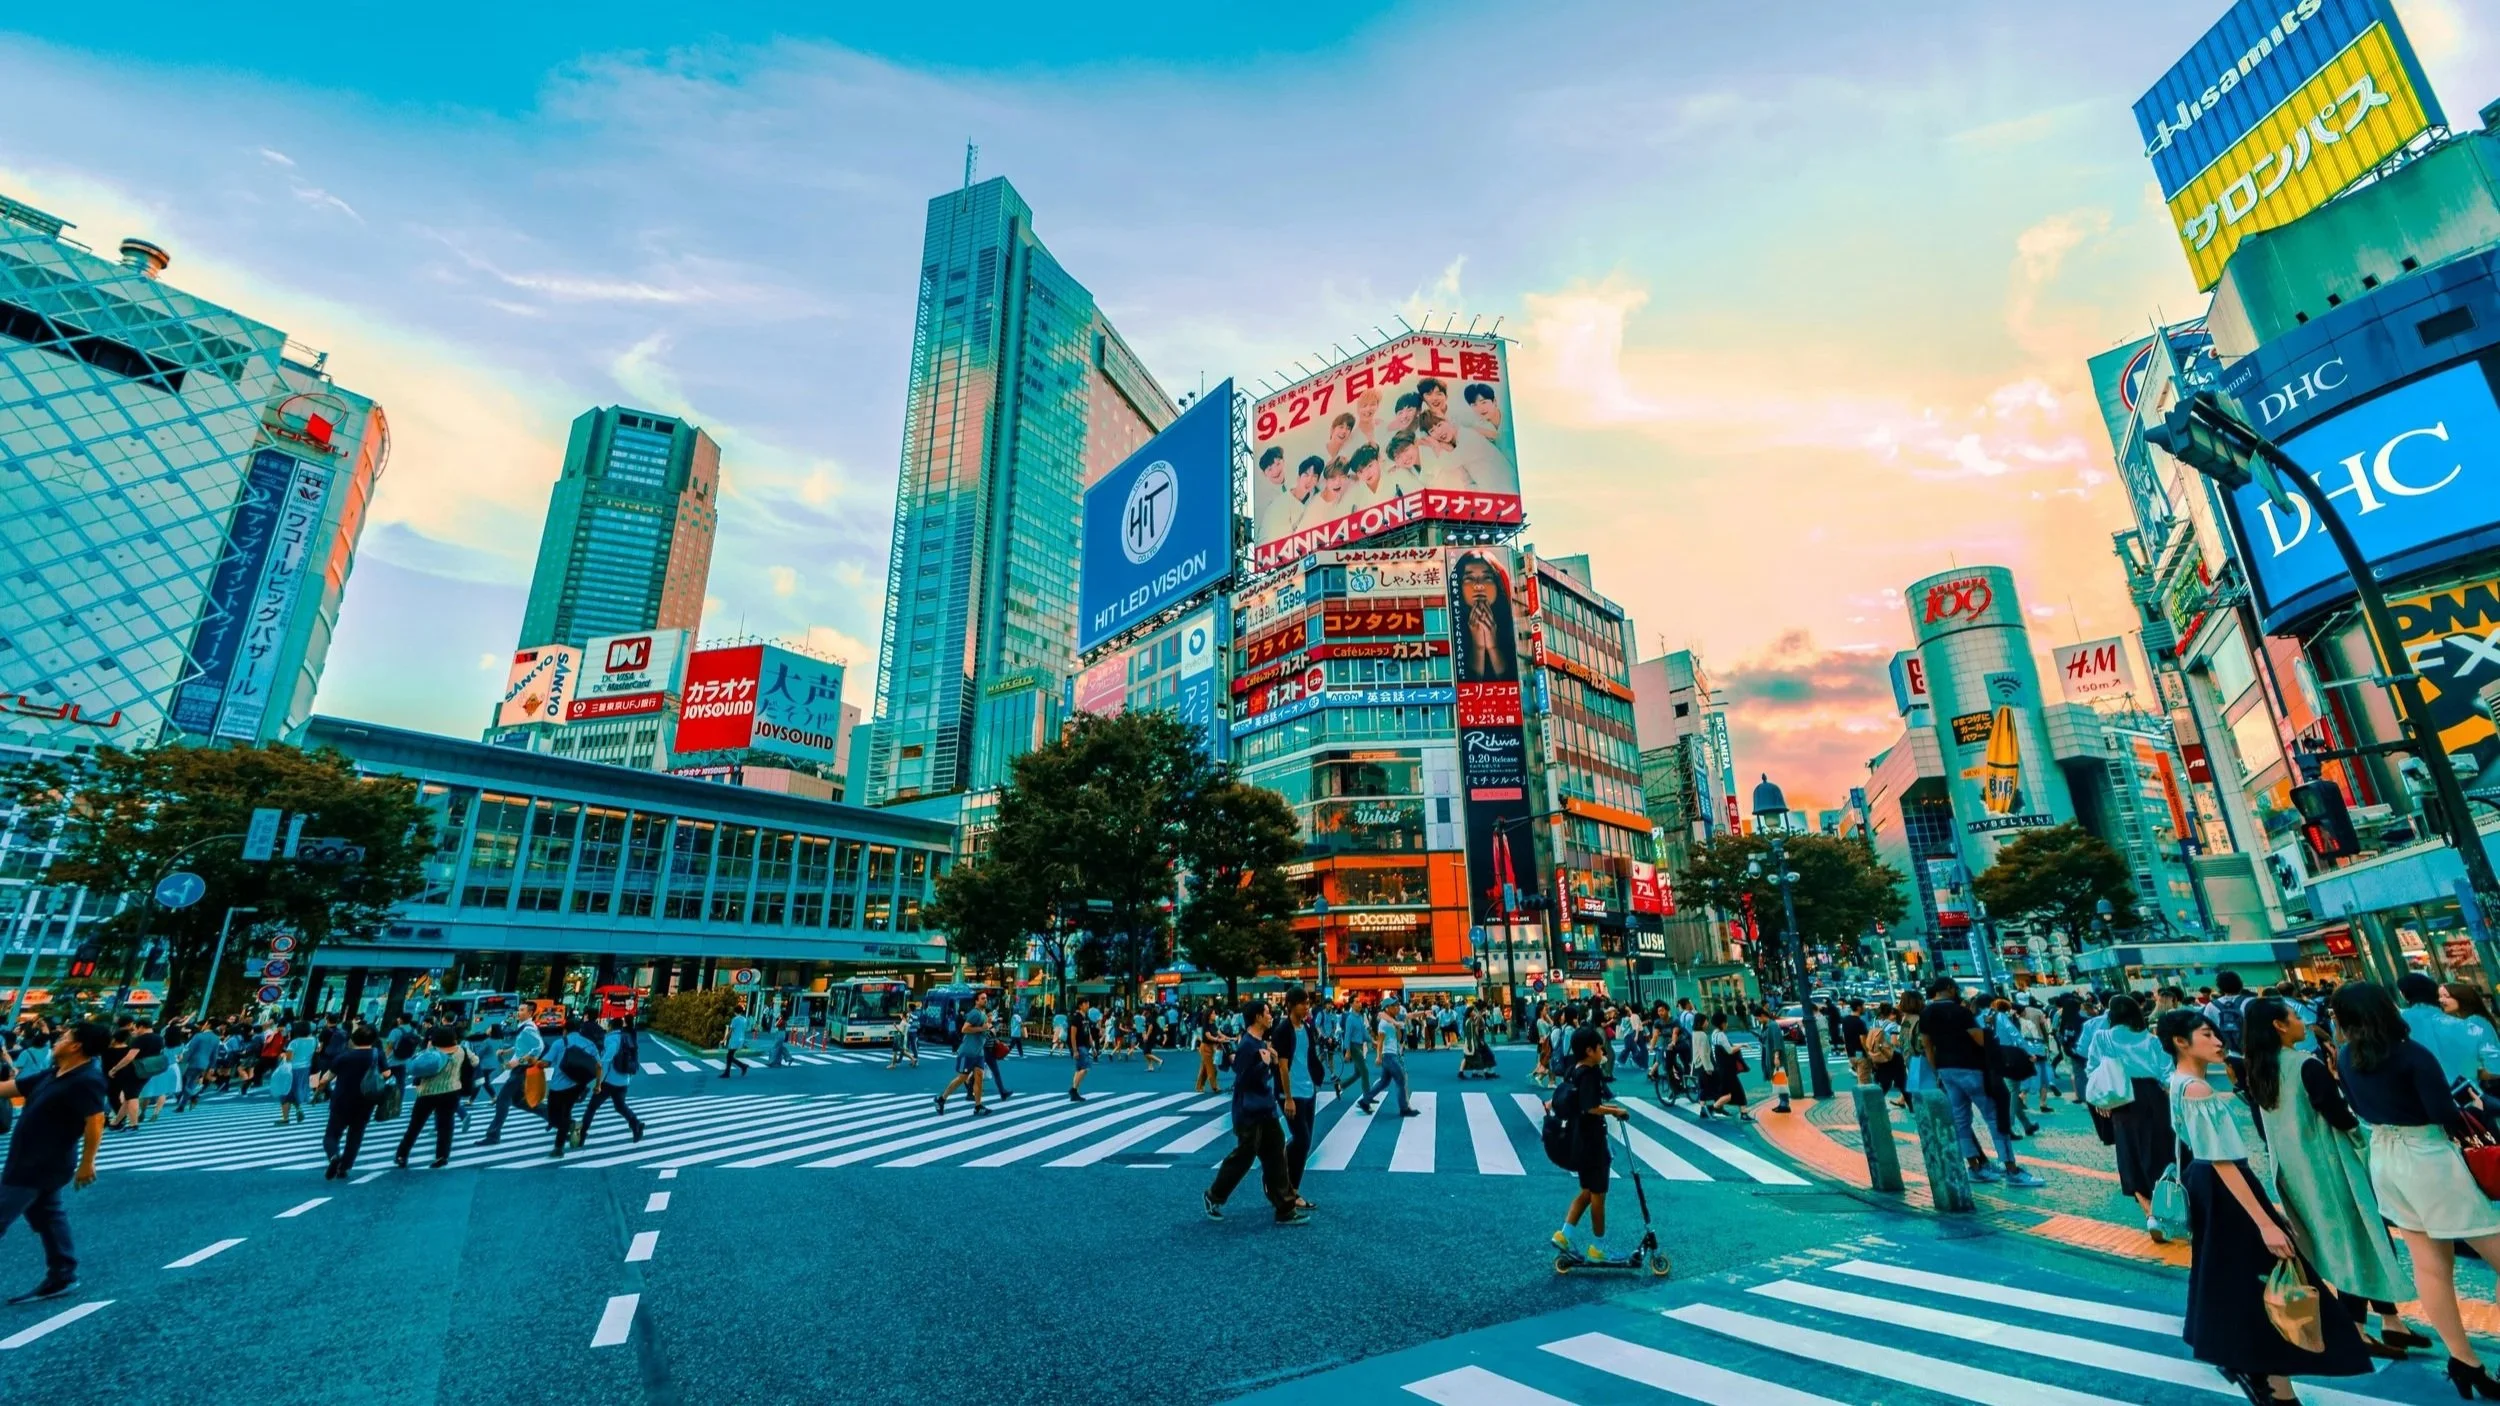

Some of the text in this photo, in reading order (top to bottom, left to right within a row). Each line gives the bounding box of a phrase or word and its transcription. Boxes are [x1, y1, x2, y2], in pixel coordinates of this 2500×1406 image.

[2183, 74, 2390, 251] サロンパス
[1257, 348, 1500, 440] 9.27 日本上陸
[2258, 356, 2348, 426] DHC
[2257, 421, 2462, 558] DHC
[1428, 495, 1517, 516] ワナワン
[1336, 548, 1437, 562] しゃぶしゃぶバイキング
[1380, 567, 1440, 587] しゃぶ葉
[1095, 550, 1207, 632] HIT LED VISION
[234, 511, 307, 696] ワコールビッグバザール
[1924, 584, 1992, 624] 109
[1235, 615, 1246, 628] 9F
[1325, 612, 1420, 631] コンタクト
[609, 641, 645, 668] DC
[1249, 625, 1305, 663] プライス
[1392, 642, 1438, 659] ガスト
[1281, 654, 1310, 677] ガスト
[2066, 644, 2116, 680] H&M
[505, 655, 553, 702] SANKYO
[547, 652, 571, 716] SANKYO
[607, 679, 652, 692] MasterCard
[616, 672, 635, 681] VISA
[763, 663, 839, 706] 大声
[2076, 682, 2109, 693] 150m
[687, 677, 755, 703] カラオケ
[1267, 681, 1302, 710] ガスト
[1367, 690, 1452, 703] 英会話イーオン
[1459, 683, 1518, 700] ユリゴコロ
[591, 698, 656, 714] 三菱東京UFJ銀行
[683, 701, 753, 720] JOYSOUND
[758, 698, 835, 732] だそうぜ
[1235, 699, 1247, 716] 7F
[1255, 701, 1306, 728] 英会話イーオン
[755, 721, 834, 750] JOYSOUND
[1961, 722, 1992, 734] ガールズ
[1963, 733, 1987, 742] パワー
[1464, 731, 1519, 752] Rihwa
[1715, 717, 1731, 770] BIC CAMERA
[1469, 754, 1490, 763] 9.20
[1349, 913, 1416, 925] L'OCCITANE
[1638, 931, 1665, 950] LUSH
